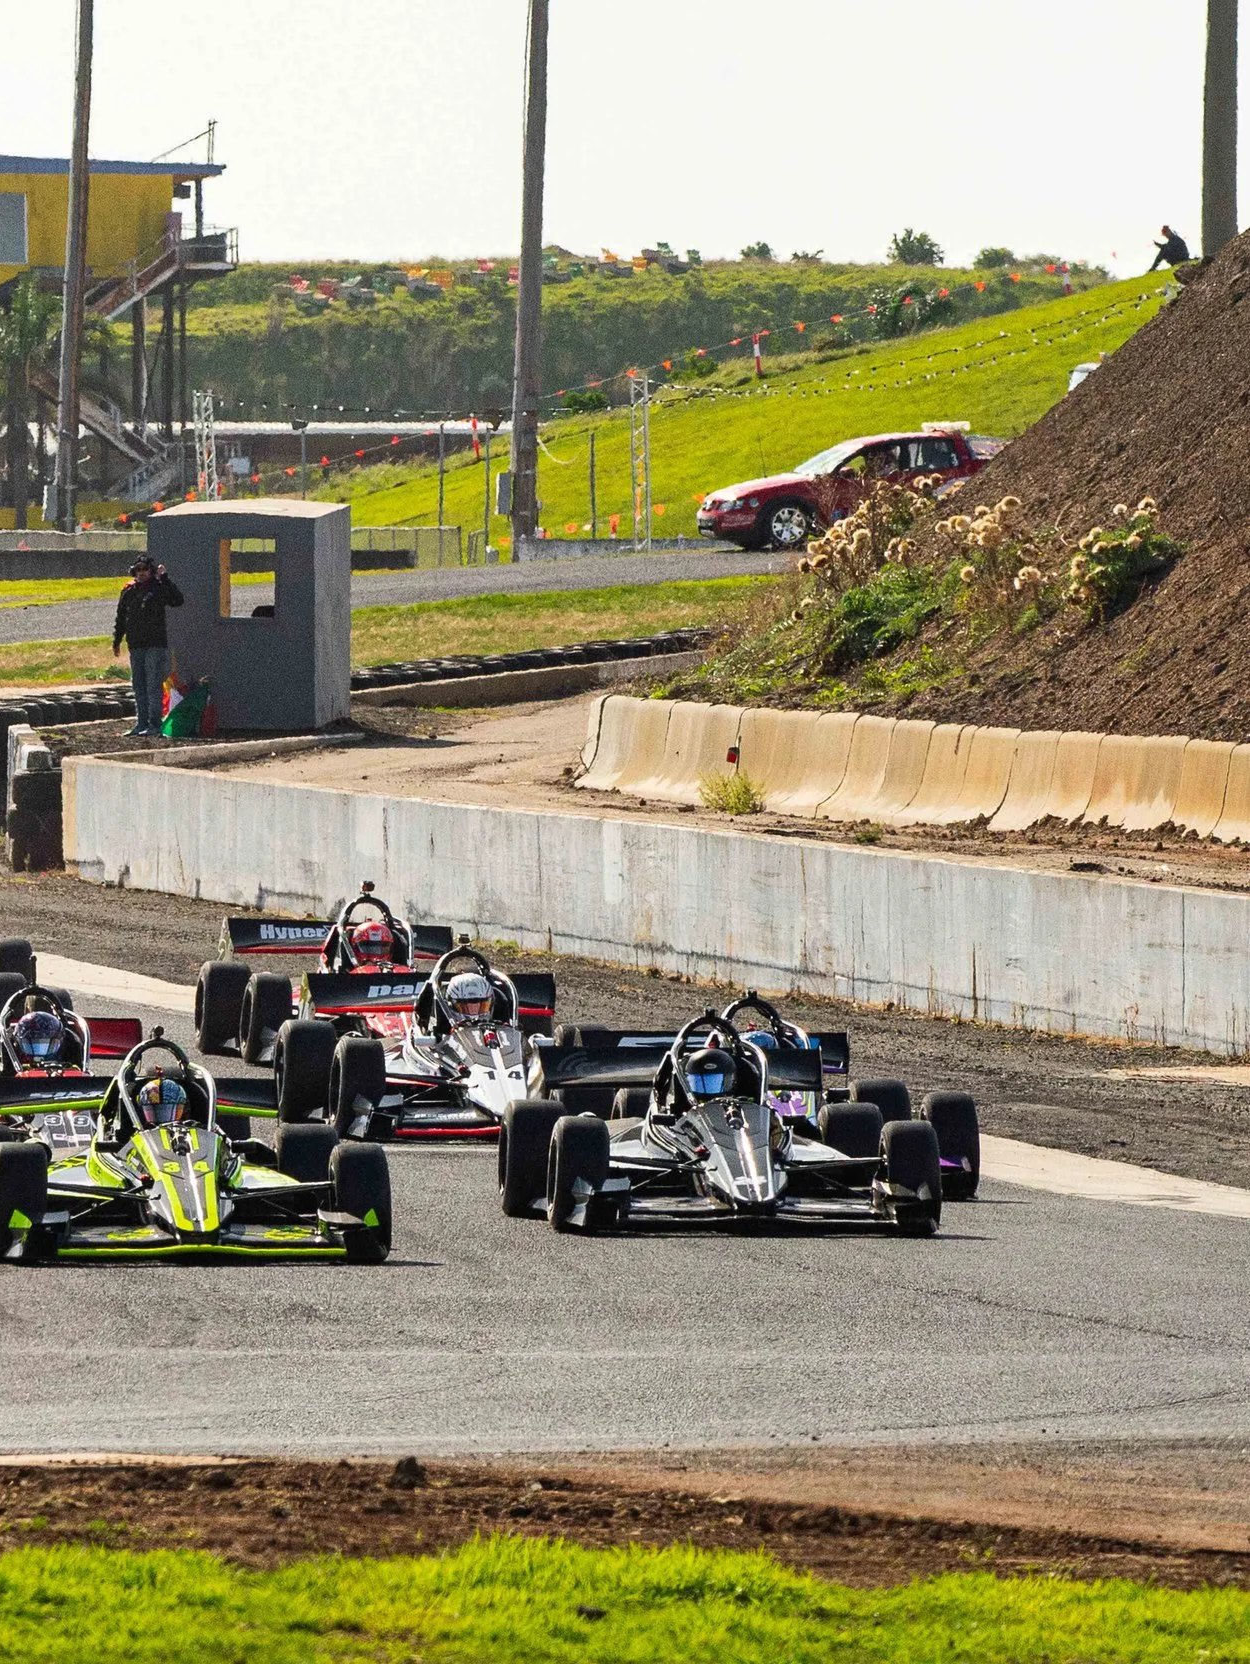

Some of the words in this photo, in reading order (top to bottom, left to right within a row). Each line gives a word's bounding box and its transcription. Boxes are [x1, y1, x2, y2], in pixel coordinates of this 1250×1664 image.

[484, 1071, 523, 1080] 14
[44, 1115, 90, 1126] 38
[163, 1162, 210, 1173] 34
